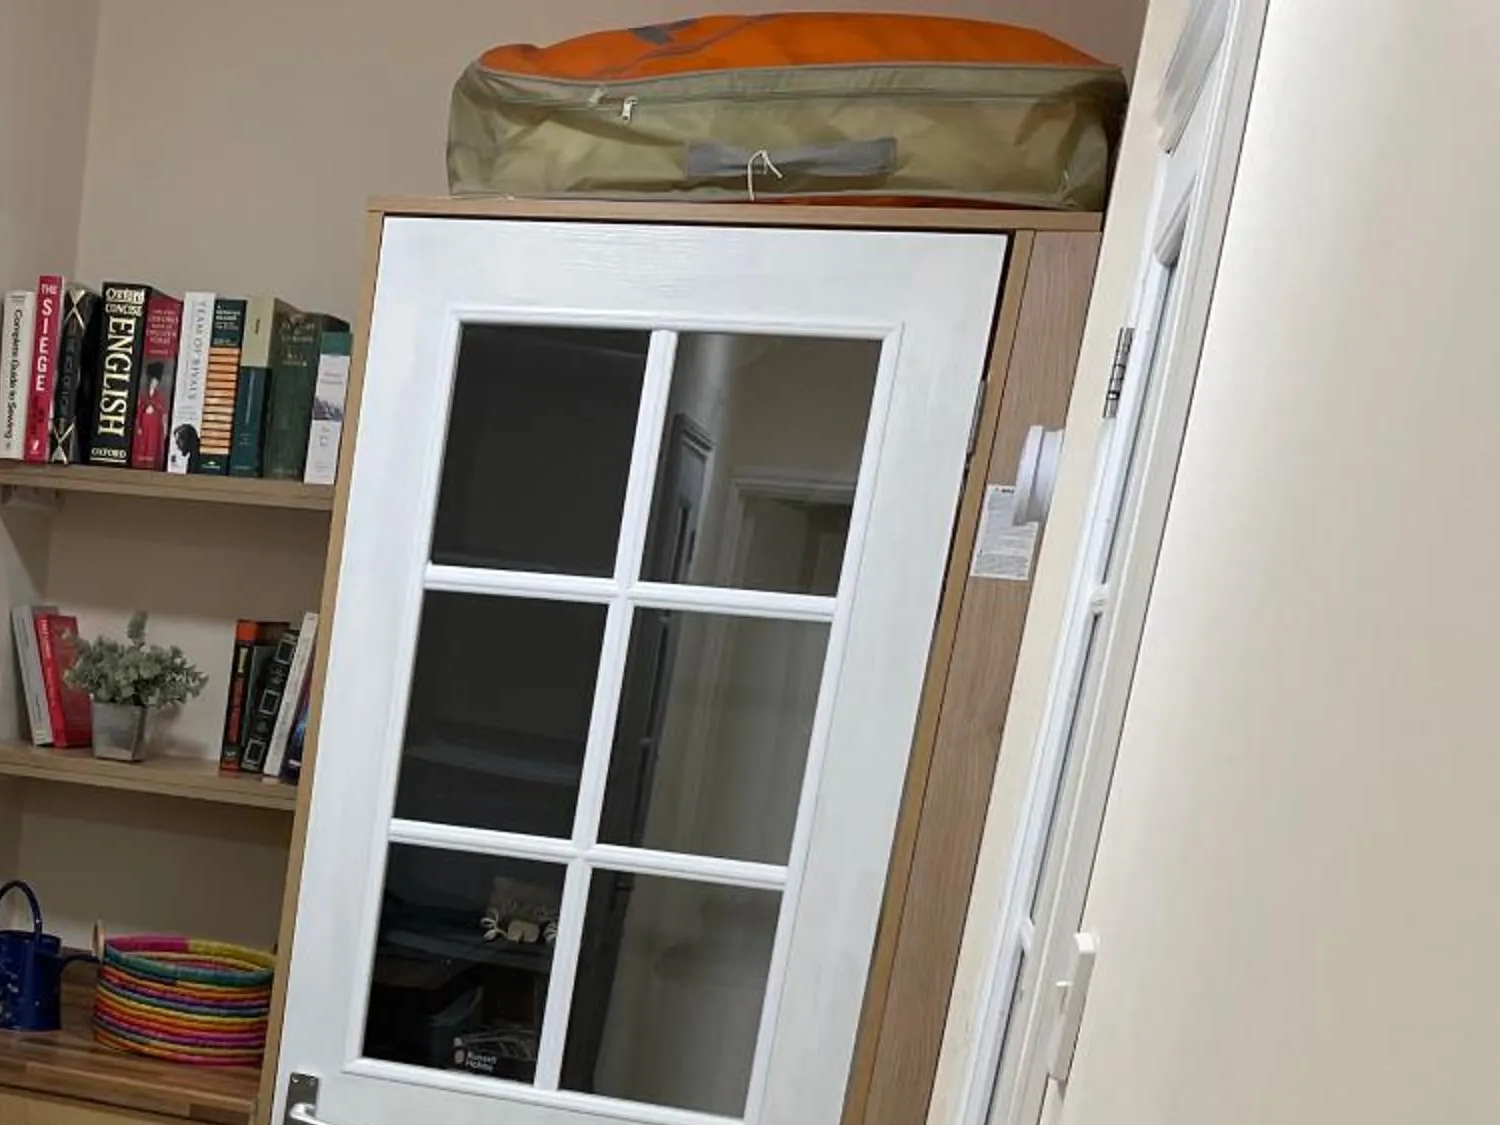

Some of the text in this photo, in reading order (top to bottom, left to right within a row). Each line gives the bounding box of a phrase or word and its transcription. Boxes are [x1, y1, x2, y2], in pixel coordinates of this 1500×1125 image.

[41, 284, 58, 295] THE
[36, 298, 53, 391] SIEGE
[97, 317, 137, 437] ENGLISH
[91, 447, 127, 458] OXFORD
